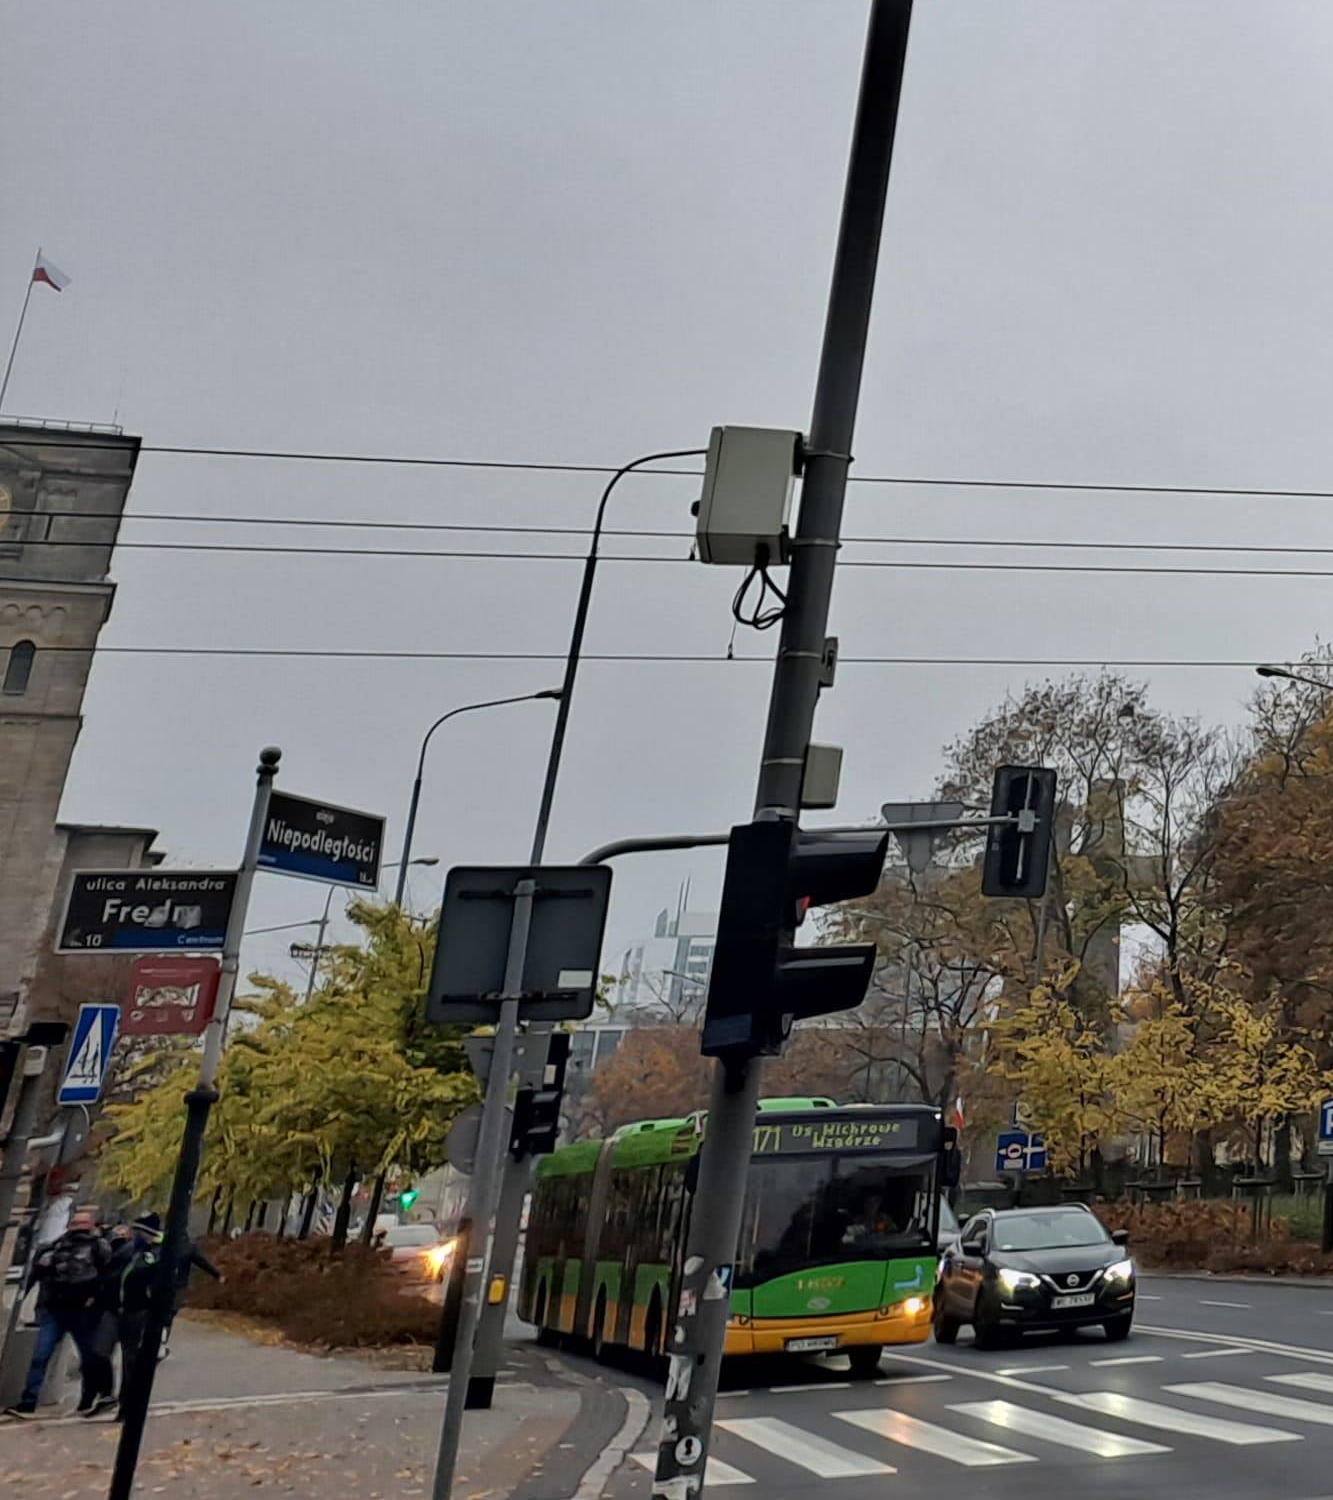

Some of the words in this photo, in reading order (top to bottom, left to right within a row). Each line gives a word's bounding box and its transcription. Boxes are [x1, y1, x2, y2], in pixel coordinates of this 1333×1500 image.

[267, 818, 375, 863] Niepodległości
[86, 878, 125, 891] ulica
[135, 878, 225, 891] Aleksandra
[752, 1126, 782, 1153] 171
